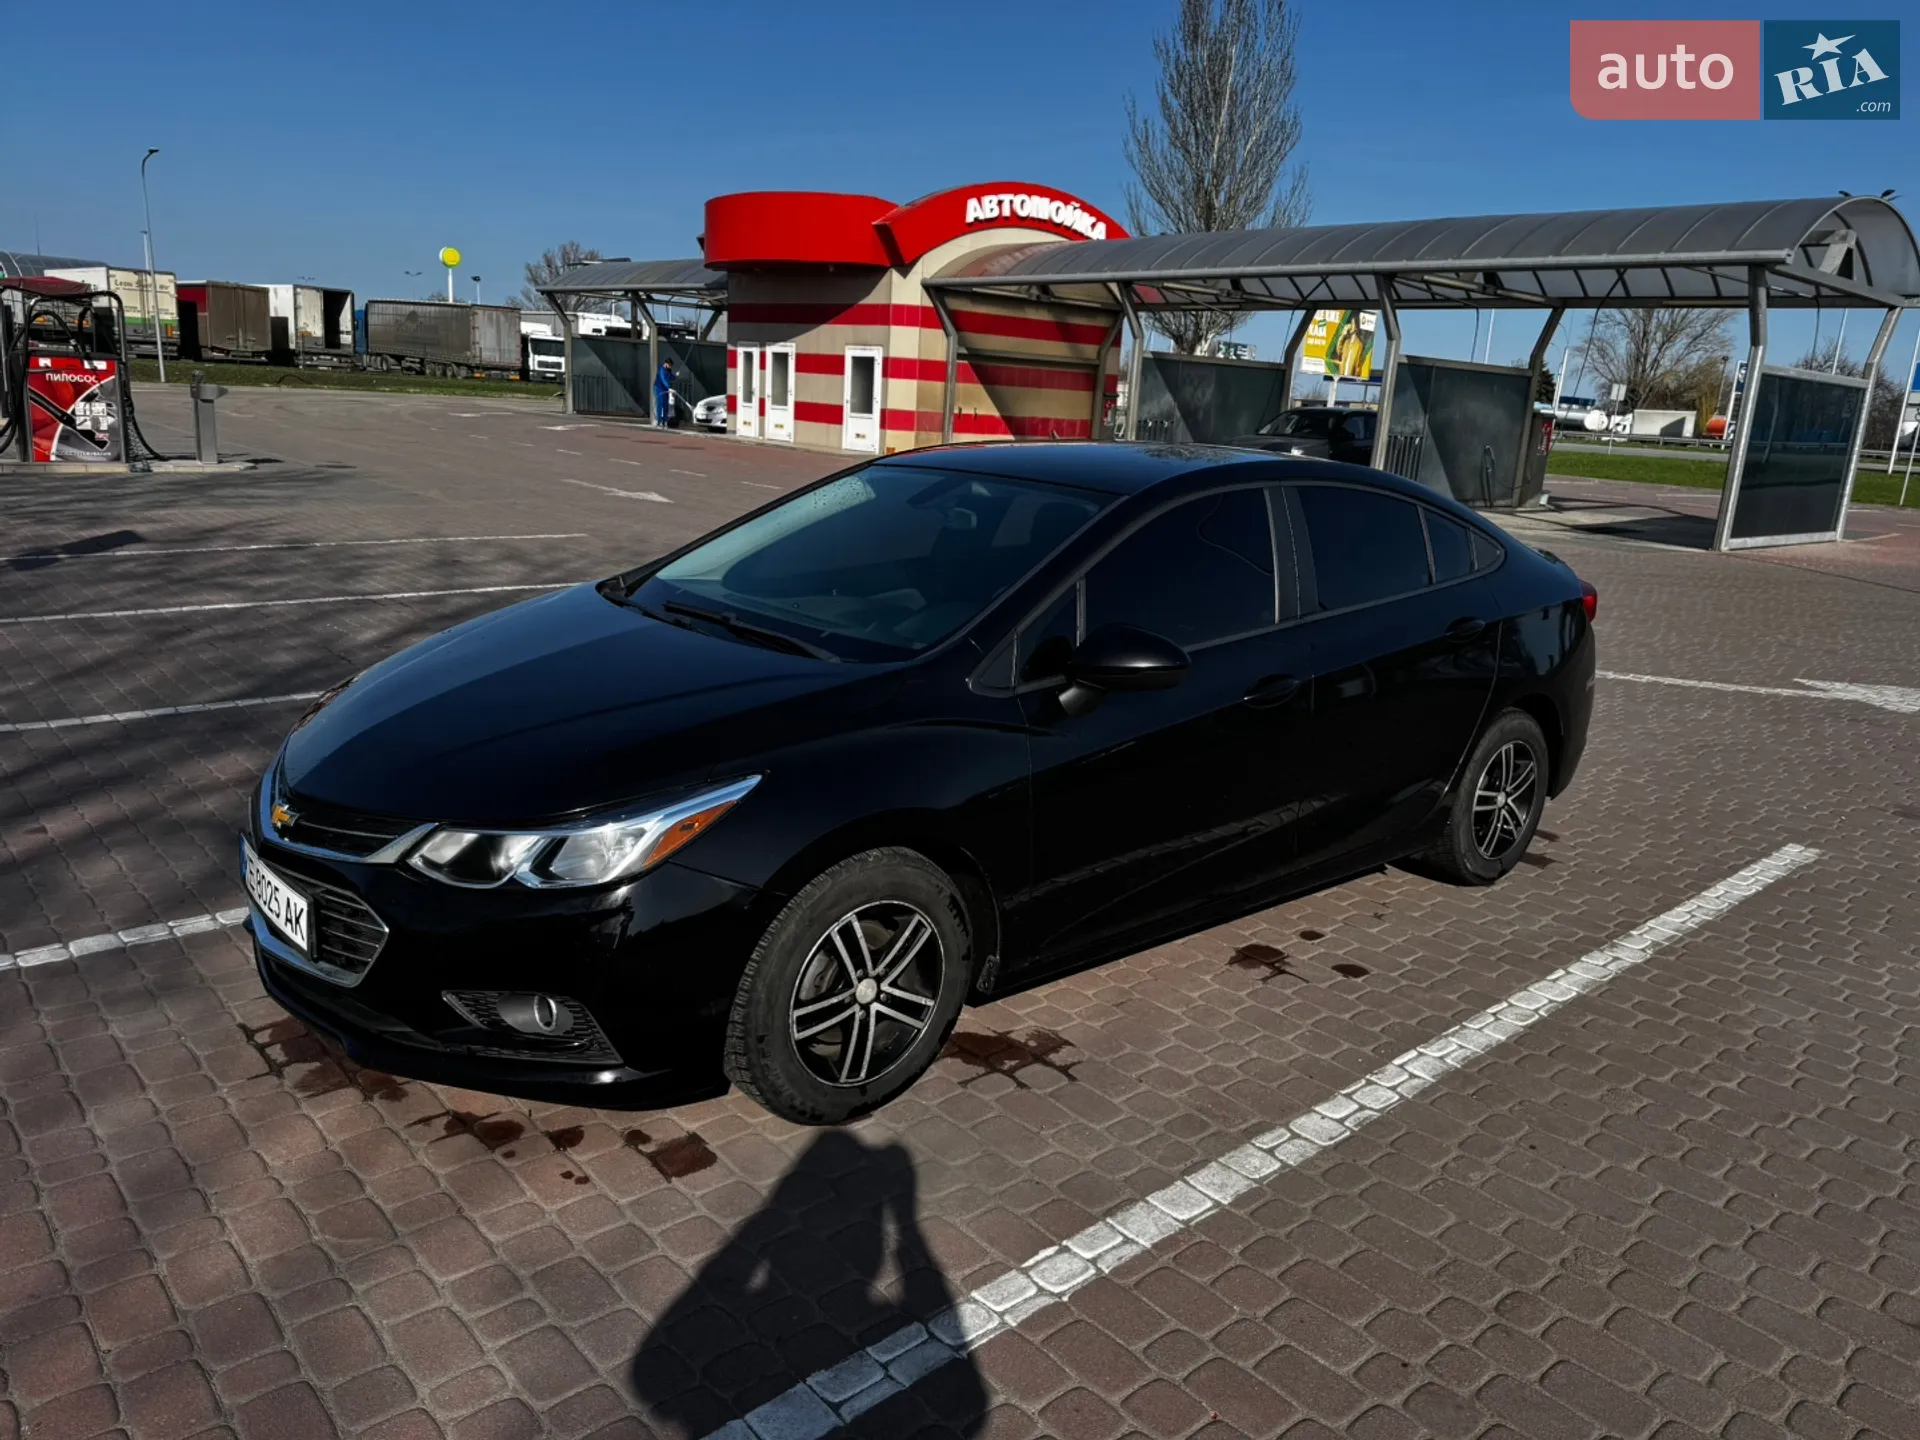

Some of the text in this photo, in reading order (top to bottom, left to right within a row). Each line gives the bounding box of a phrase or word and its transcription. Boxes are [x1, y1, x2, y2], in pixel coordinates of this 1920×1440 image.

[965, 193, 1107, 240] АВТОМОЙКА
[256, 868, 281, 919] 8025
[284, 896, 305, 942] AK
